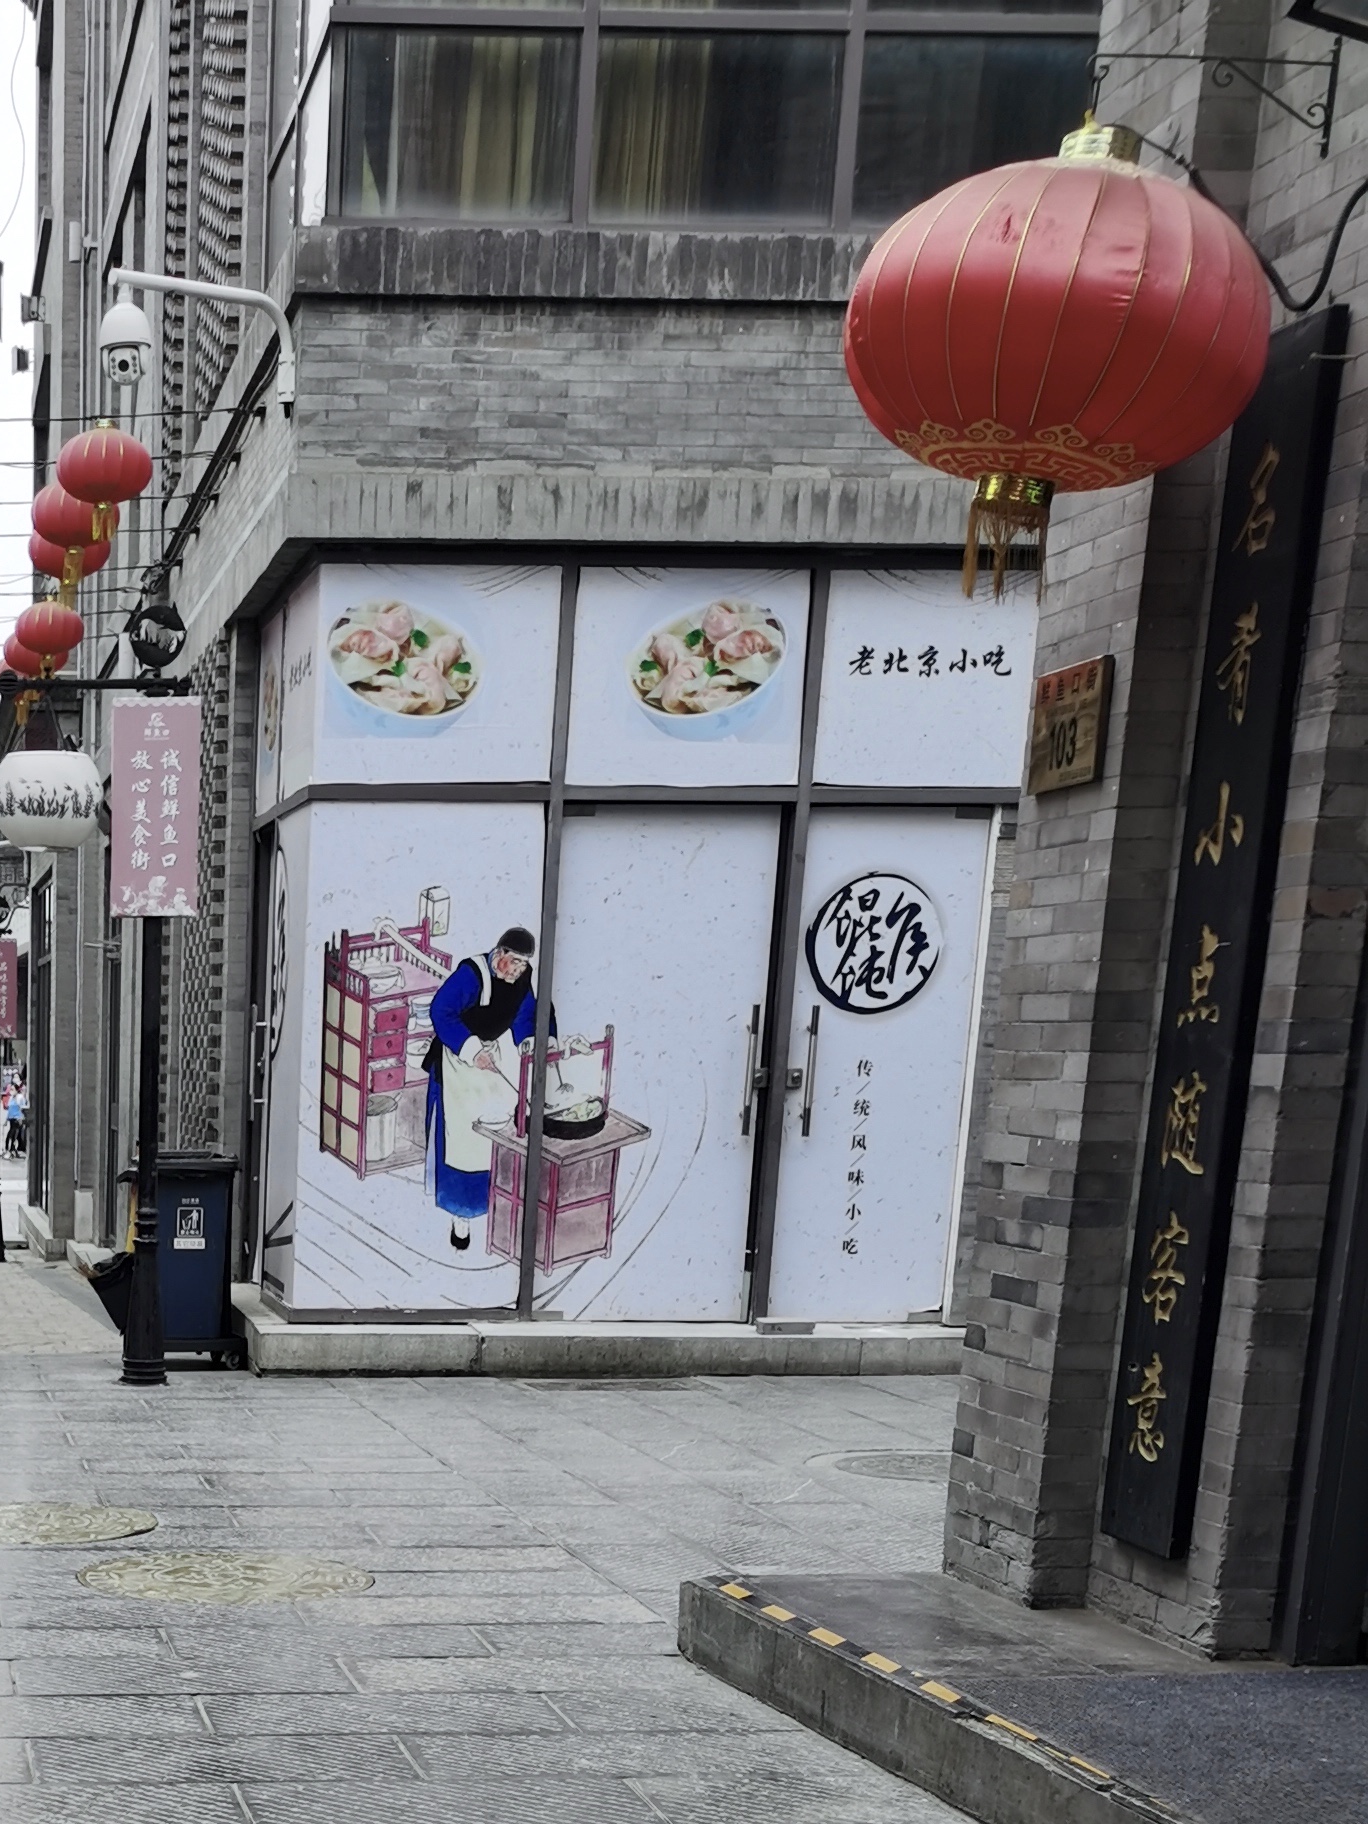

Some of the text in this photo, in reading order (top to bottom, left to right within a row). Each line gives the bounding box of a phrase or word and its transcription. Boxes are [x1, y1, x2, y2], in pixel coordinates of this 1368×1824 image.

[848, 644, 1013, 680] 老北京小吃
[1049, 715, 1078, 771] 103
[131, 750, 153, 871] 放心美食街
[160, 749, 182, 868] 诚信鲜鱼口
